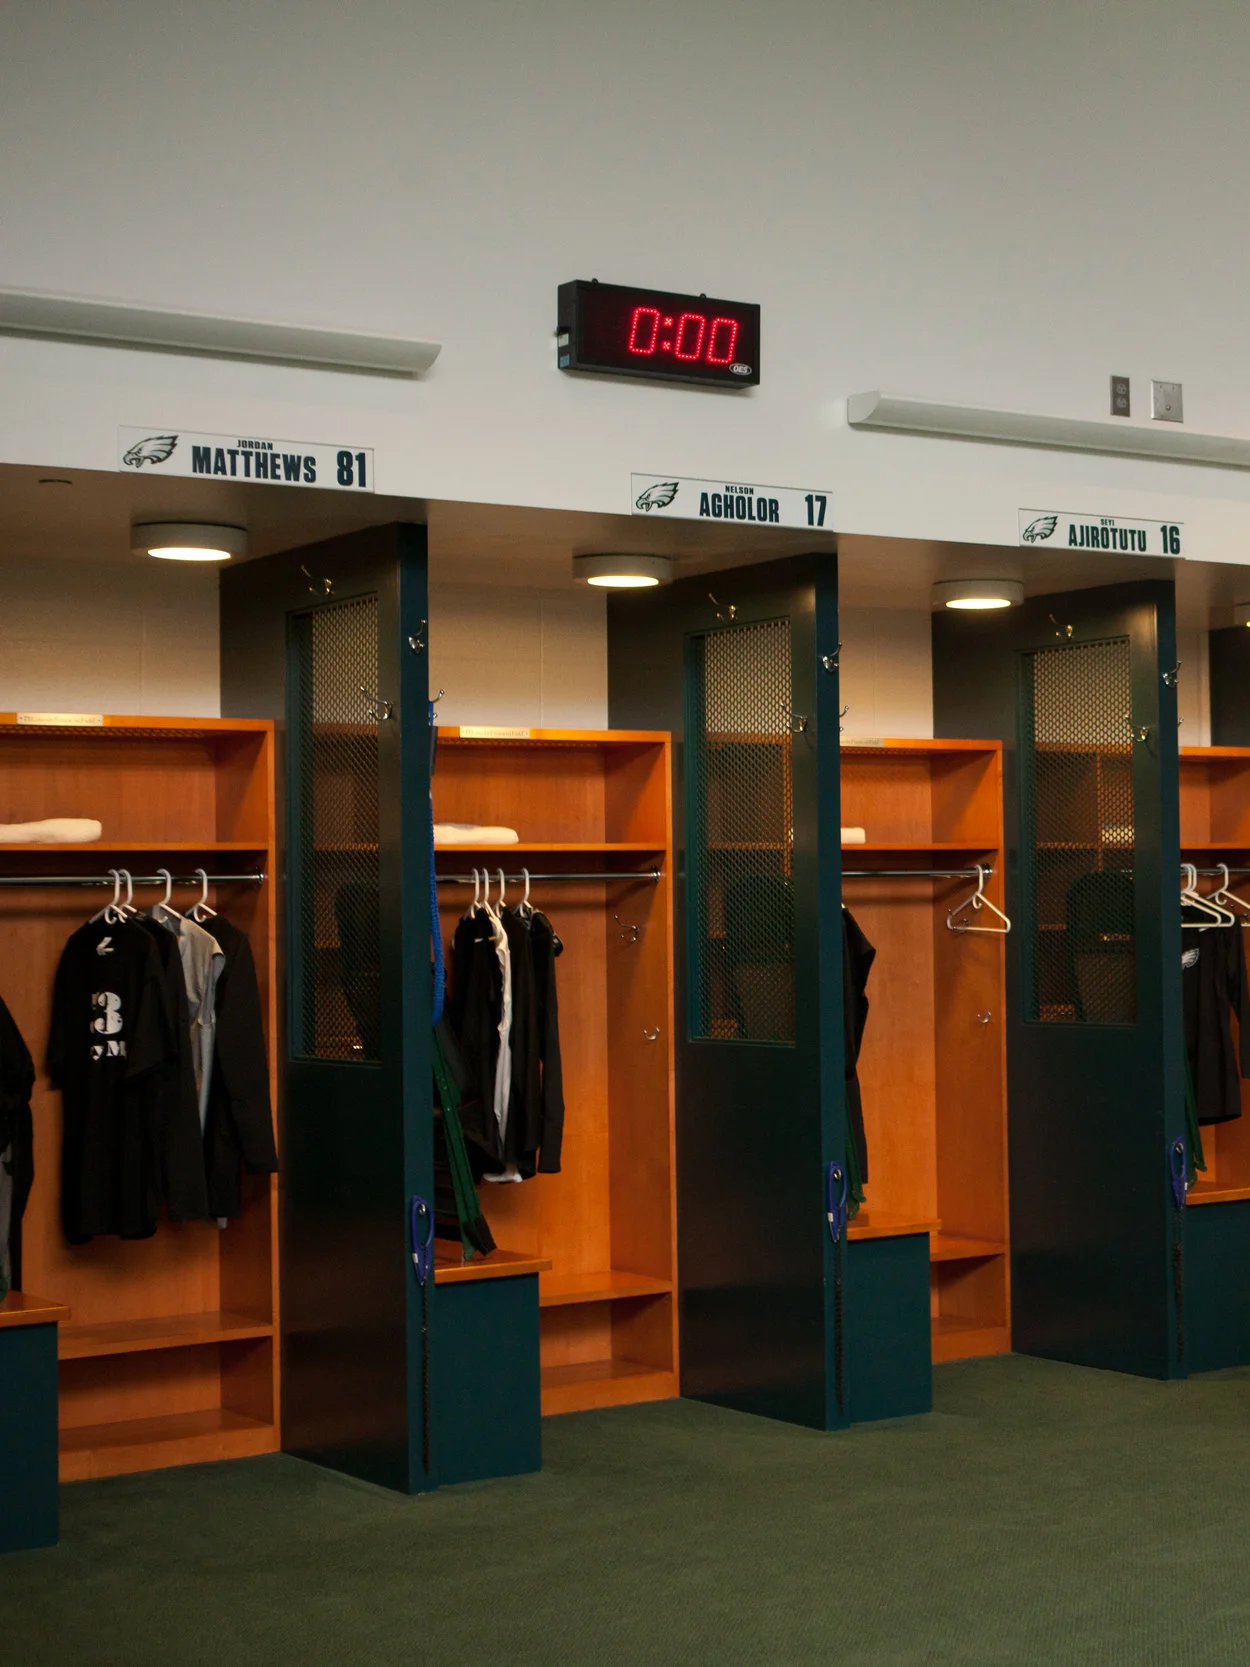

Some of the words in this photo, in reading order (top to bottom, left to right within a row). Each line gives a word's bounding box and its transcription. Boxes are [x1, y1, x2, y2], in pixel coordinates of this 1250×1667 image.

[628, 306, 738, 364] 0:00
[237, 439, 274, 451] JORDAN
[191, 445, 316, 483] MATTHEWS
[336, 450, 367, 488] 81
[725, 485, 754, 495] NELSON
[699, 492, 780, 523] AGHOLOR
[804, 494, 827, 527] 17
[1100, 518, 1115, 526] SEYI
[1068, 524, 1147, 552] AJIROTUTU
[1160, 525, 1181, 555] 16
